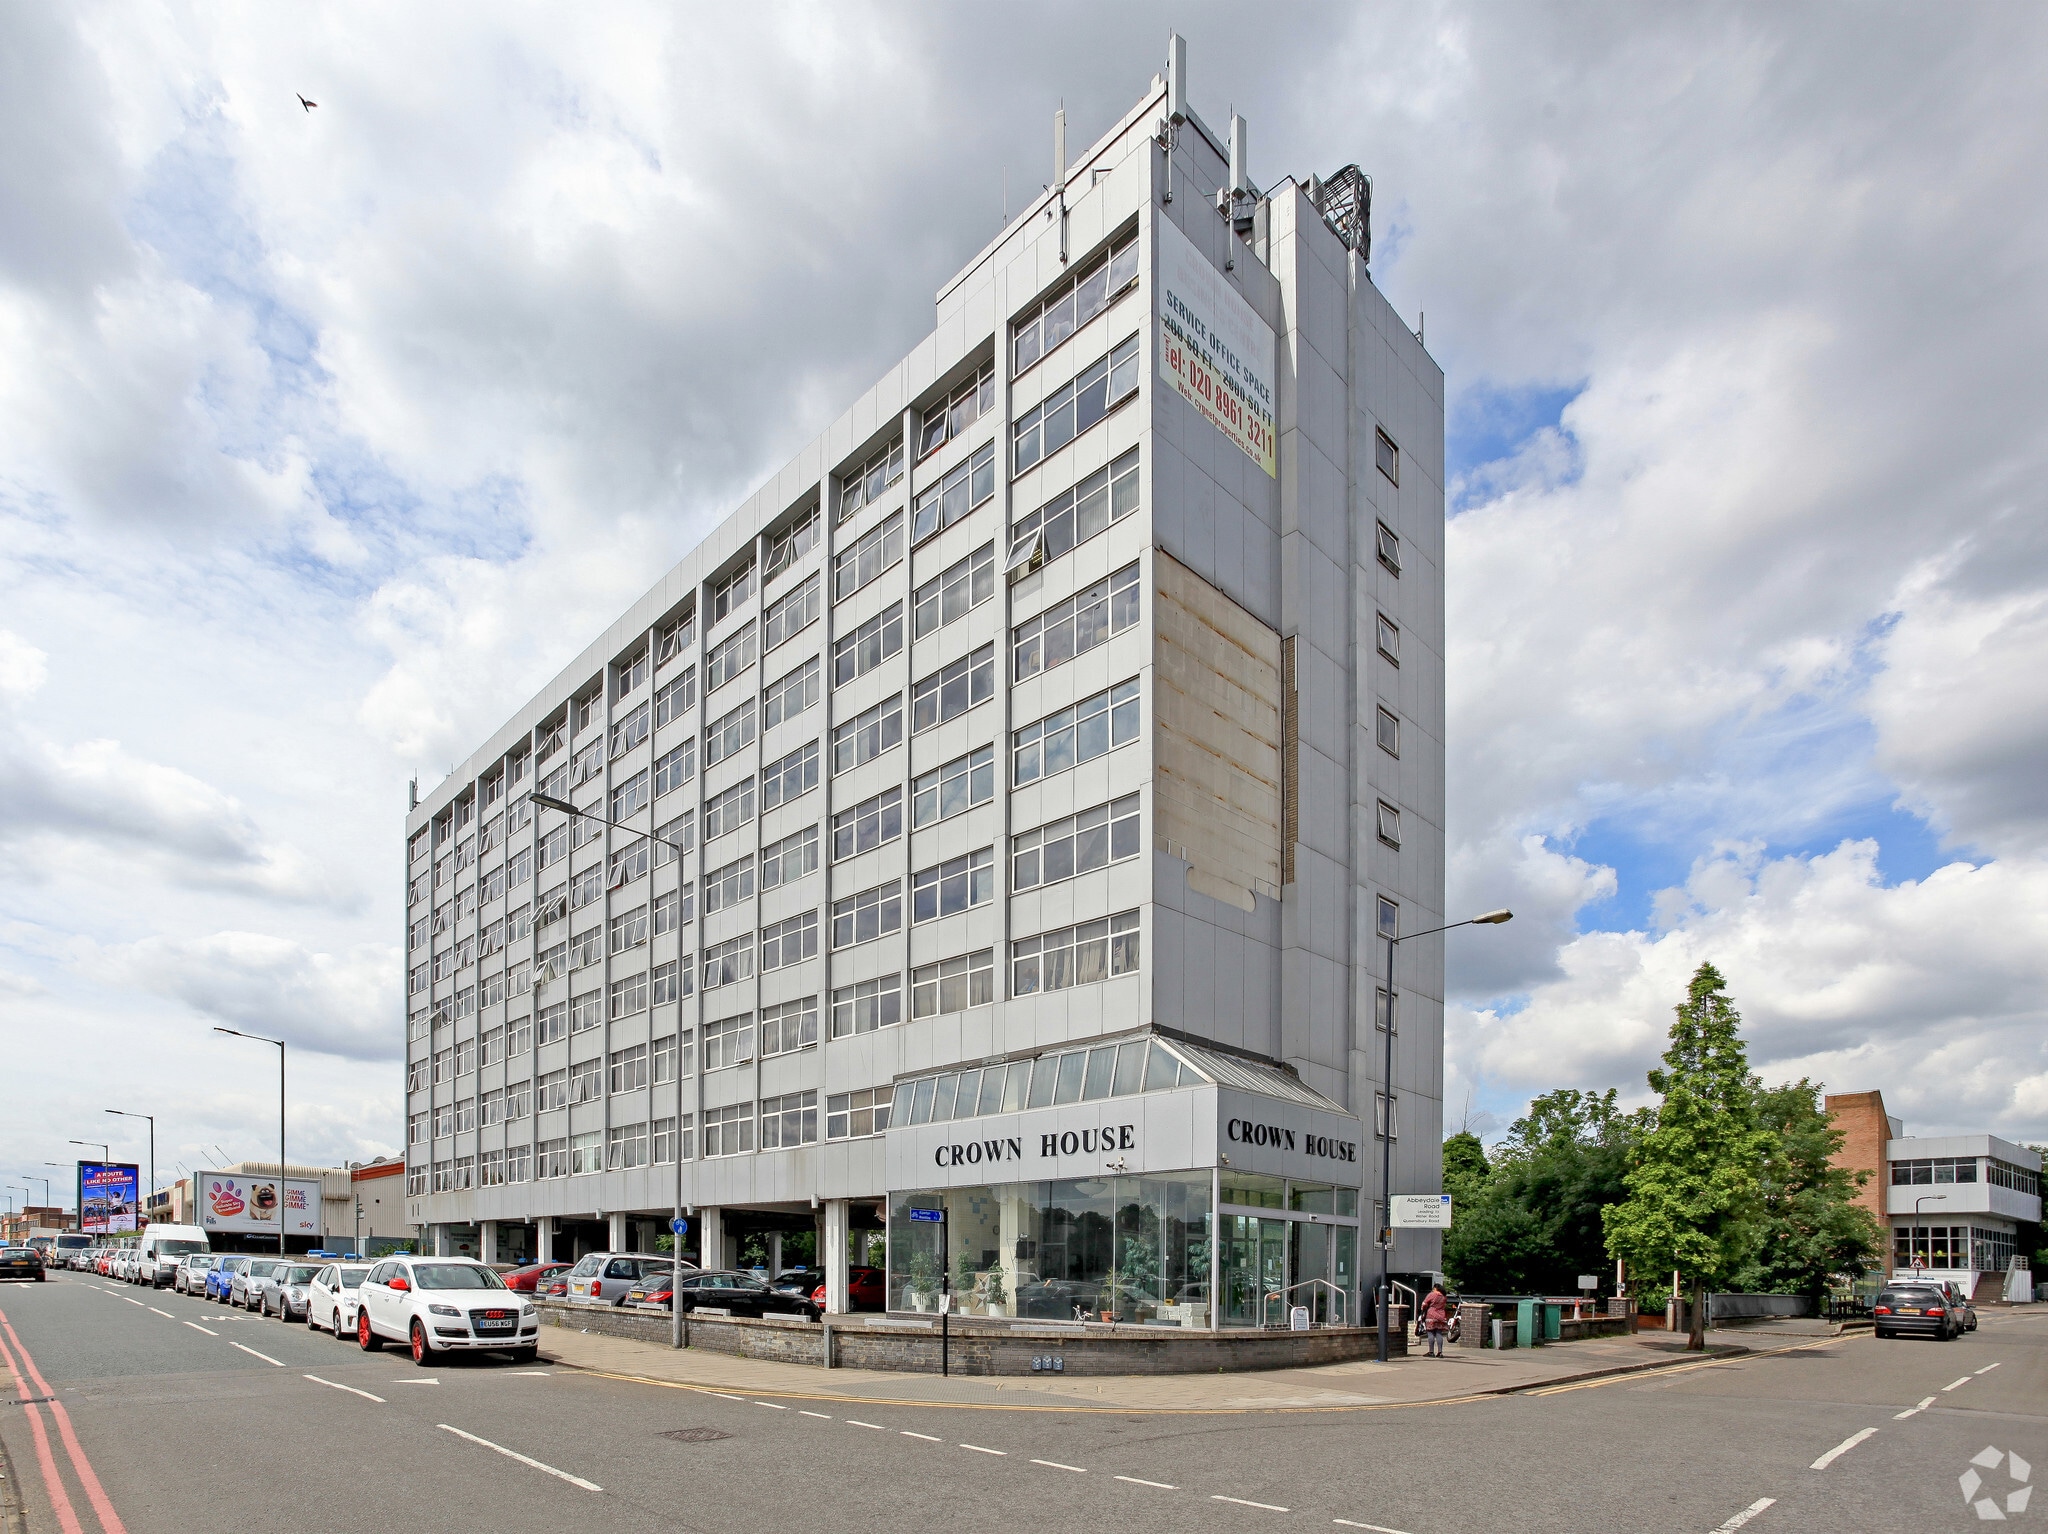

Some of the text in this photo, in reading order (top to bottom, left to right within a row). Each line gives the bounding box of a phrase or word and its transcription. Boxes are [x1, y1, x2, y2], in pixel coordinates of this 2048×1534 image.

[1166, 289, 1270, 405] SERVICE OFFICE SPACE
[1164, 313, 1184, 343] 200
[1186, 333, 1199, 359] SQ
[1202, 347, 1213, 371] FT
[1223, 370, 1245, 402] 2000
[1248, 393, 1260, 416] SQ
[1262, 407, 1273, 428] FT
[1177, 379, 1193, 403] Web:
[1189, 359, 1212, 402] 020
[1215, 384, 1243, 432] 8961
[1247, 414, 1273, 458] 3211
[935, 1124, 1135, 1168] CROWN HOUSE
[1228, 1118, 1357, 1162] CROWN HOUSE
[285, 1194, 307, 1202] GIMME
[299, 1221, 314, 1230] sky
